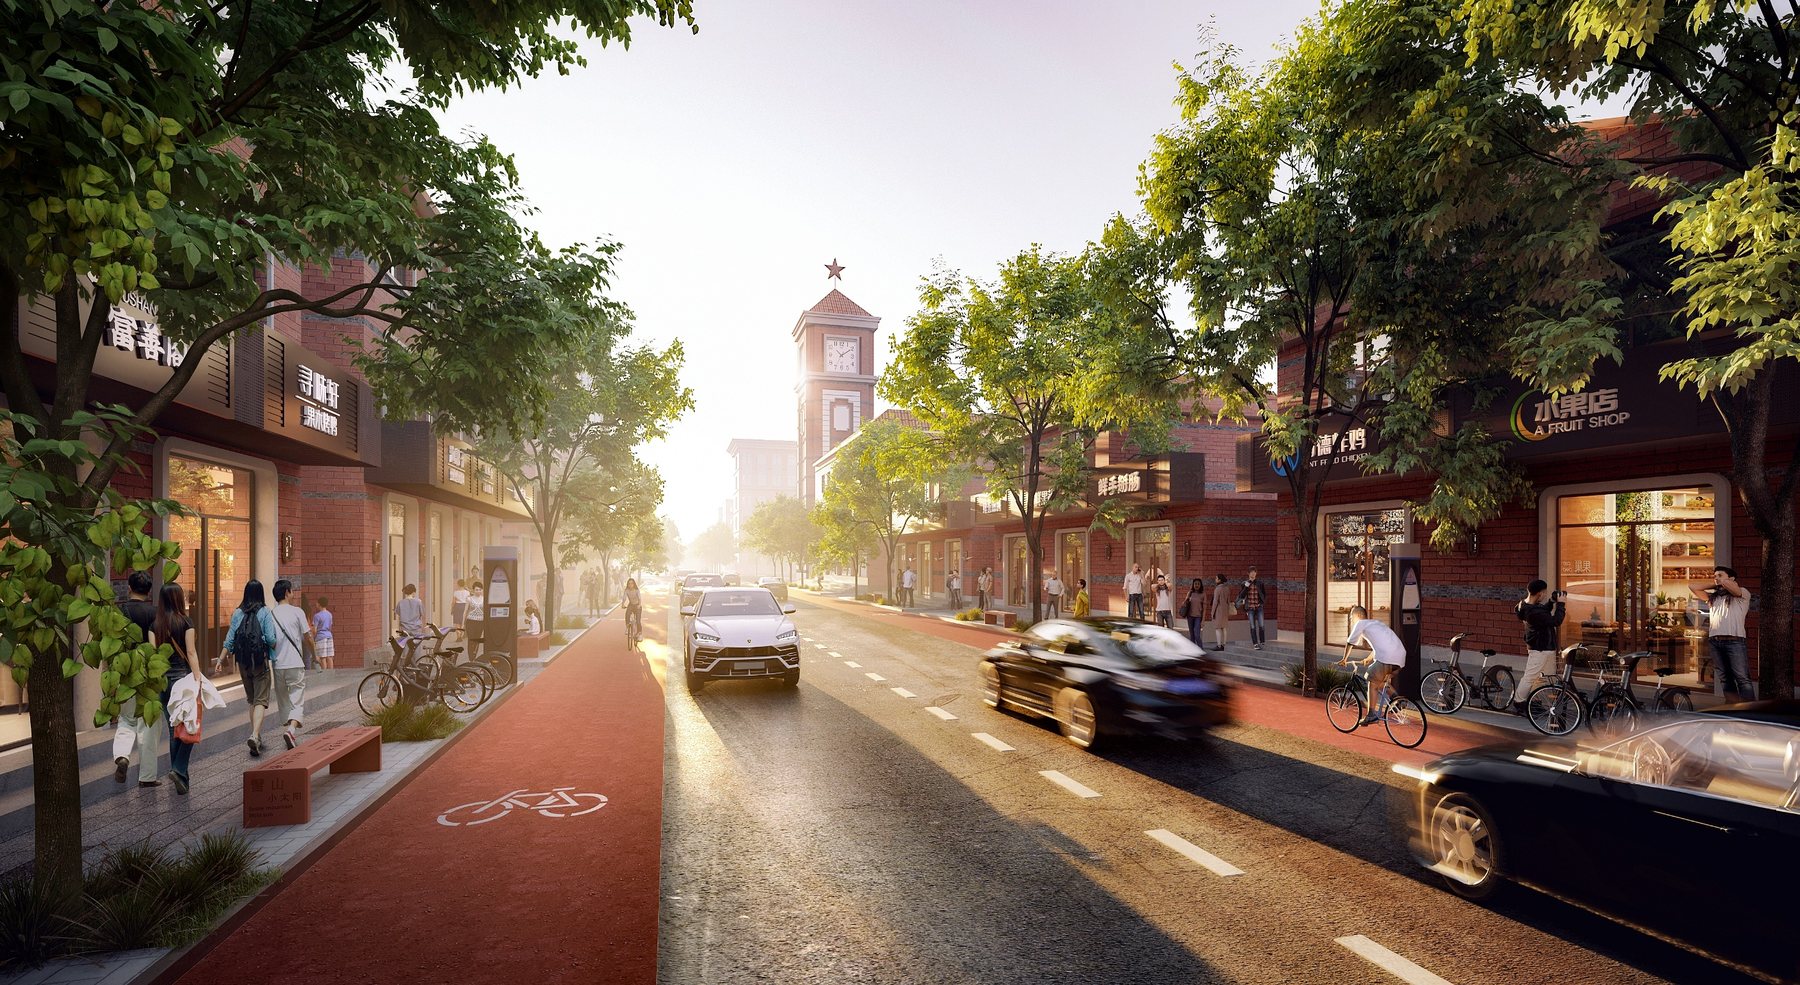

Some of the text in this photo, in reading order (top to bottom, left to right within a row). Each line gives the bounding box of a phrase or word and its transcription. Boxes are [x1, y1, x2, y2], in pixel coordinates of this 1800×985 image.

[298, 364, 339, 409] 寻味轩
[1534, 388, 1619, 422] 水果店
[1534, 411, 1631, 436] A FRUIT SHOP
